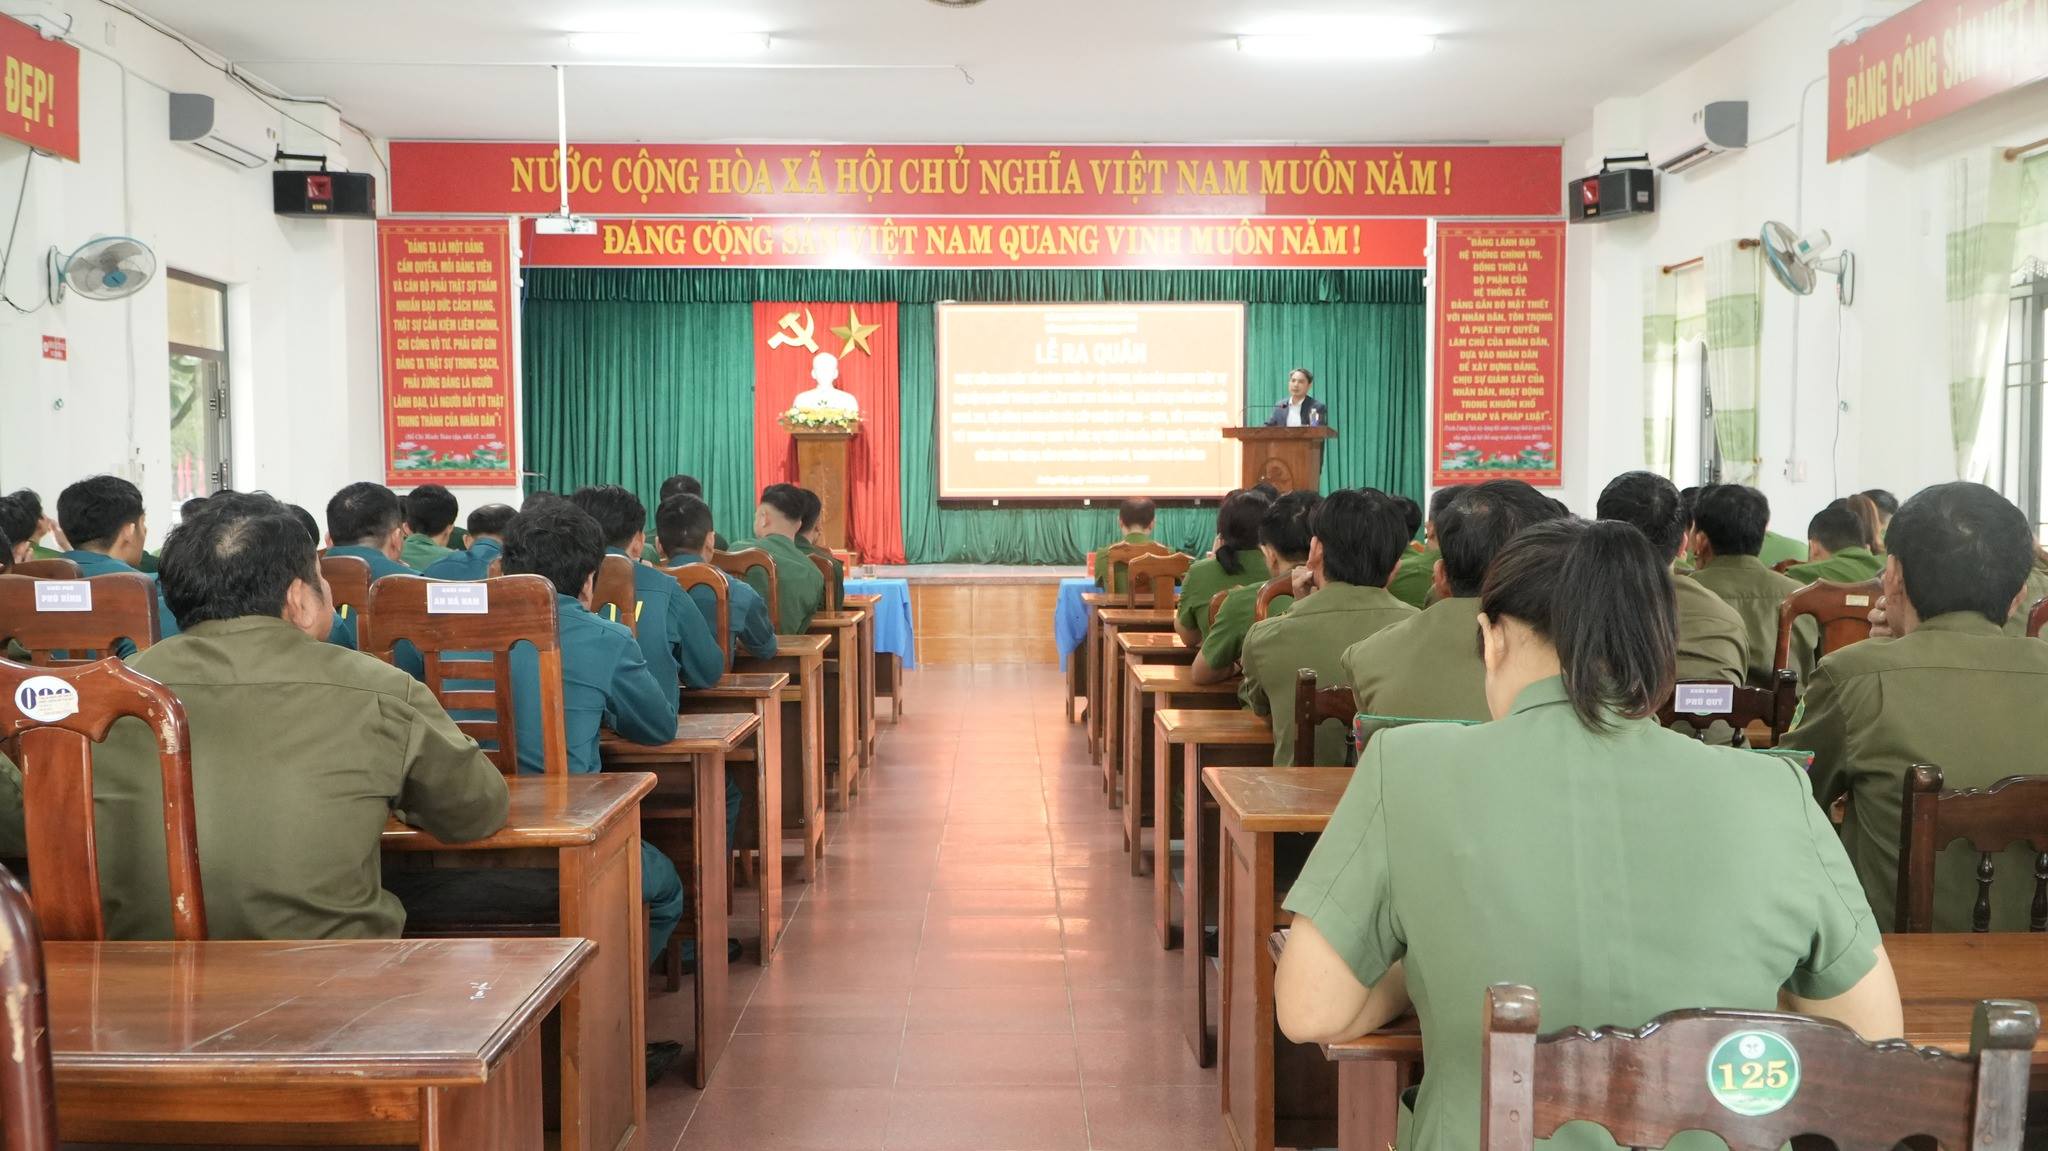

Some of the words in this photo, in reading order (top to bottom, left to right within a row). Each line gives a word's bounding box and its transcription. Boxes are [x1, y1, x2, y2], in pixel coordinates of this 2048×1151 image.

[4, 55, 55, 133] ĐẸP!
[1846, 54, 1887, 131] ĐẢNG
[1892, 33, 1937, 119] CỘNG
[1943, 4, 1977, 90] SẢN
[511, 145, 602, 194] NƯỚC
[612, 148, 700, 204] CỘNG
[708, 148, 774, 194] HÒA
[781, 150, 826, 194] XÃ
[835, 148, 894, 202] HỘI
[900, 145, 970, 194] CHỦ
[979, 150, 1085, 195] NGHĨA
[1089, 150, 1167, 203] VIỆT
[1176, 160, 1248, 195] NAM
[1259, 149, 1356, 195] MUÔN
[693, 219, 774, 262] CỘNG
[845, 218, 918, 261] VIỆT
[925, 225, 992, 255] NAM
[999, 225, 1101, 261] QUANG
[1105, 224, 1183, 255] VINH
[1190, 218, 1275, 255] MUÔN
[1718, 1060, 1789, 1091] 125
